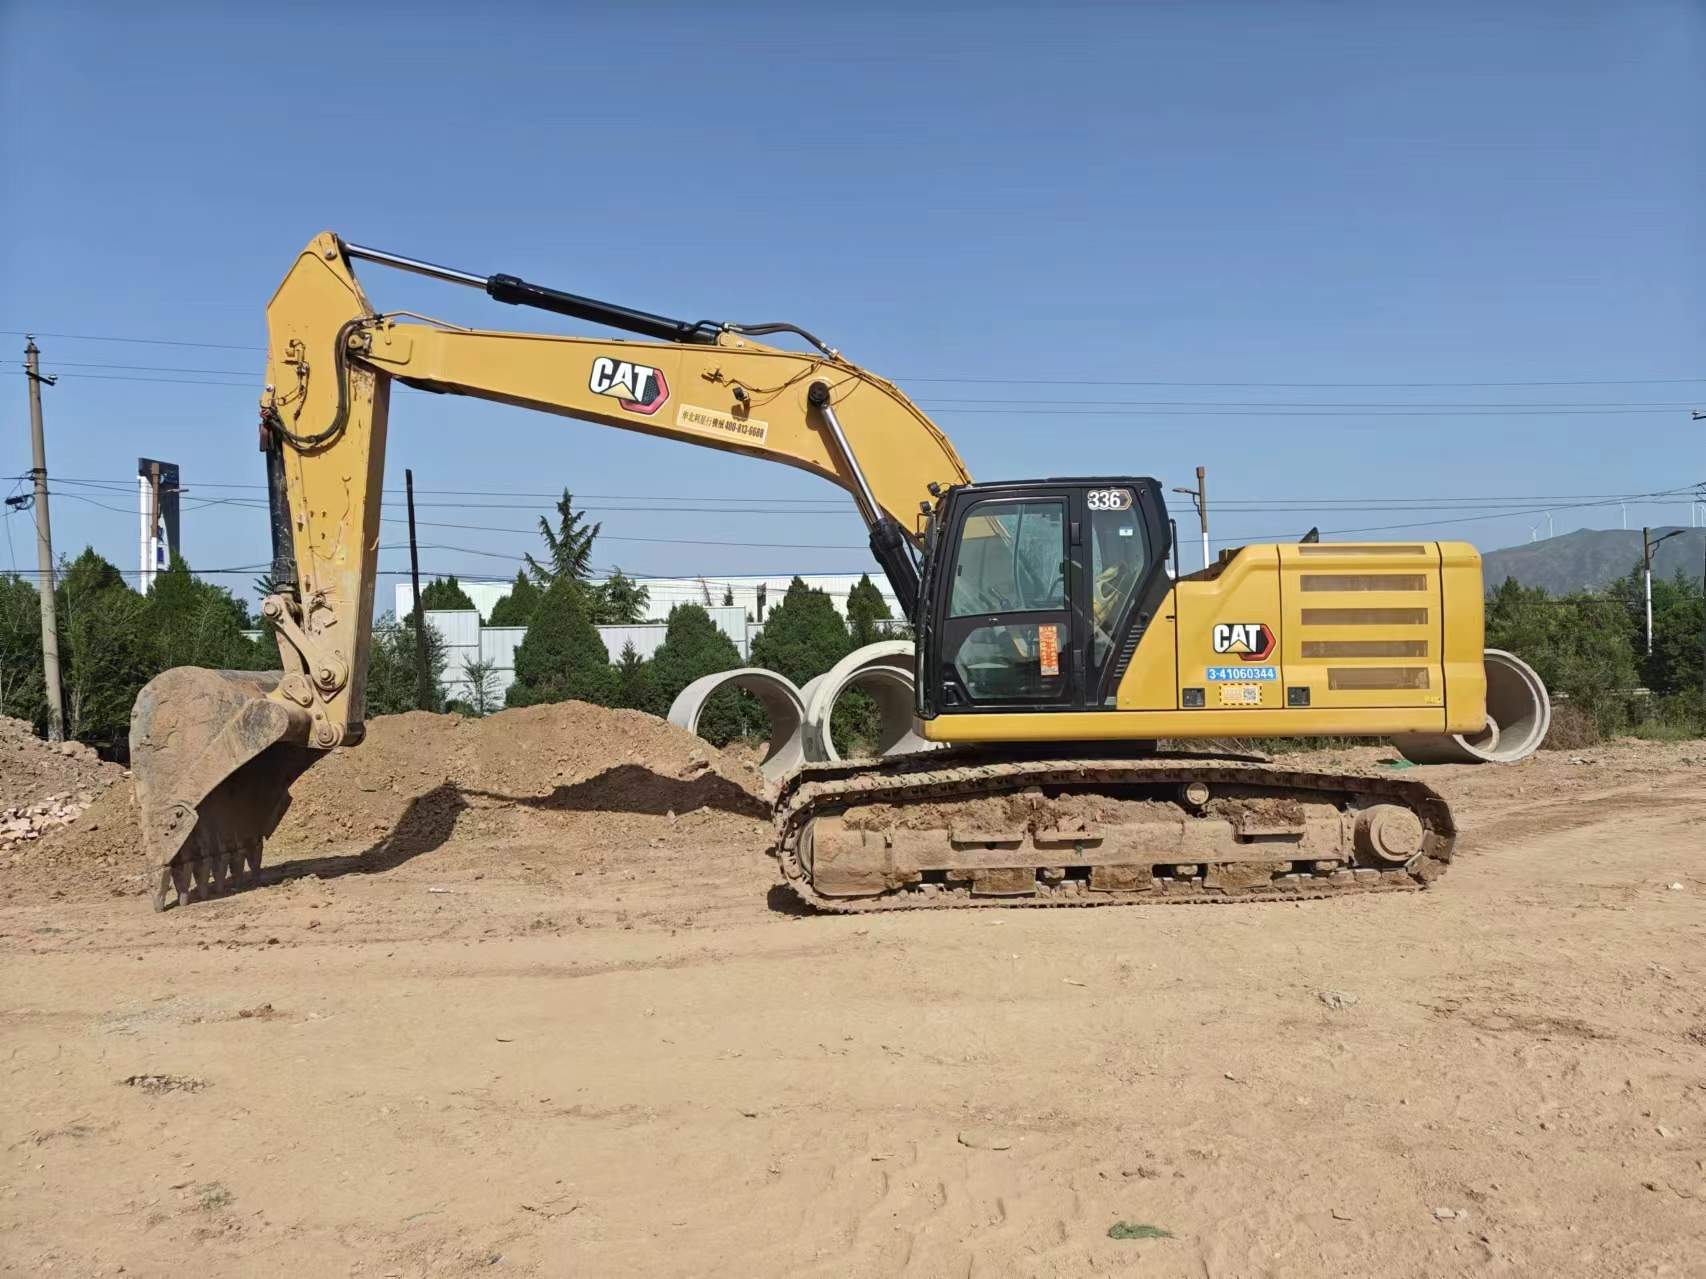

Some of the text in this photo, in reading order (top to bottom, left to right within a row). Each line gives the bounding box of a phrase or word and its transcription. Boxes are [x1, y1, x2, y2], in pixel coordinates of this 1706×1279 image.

[590, 357, 653, 402] CAT
[1089, 491, 1121, 508] 336
[1214, 624, 1261, 653] CAT
[1208, 668, 1274, 679] 3-41060344
